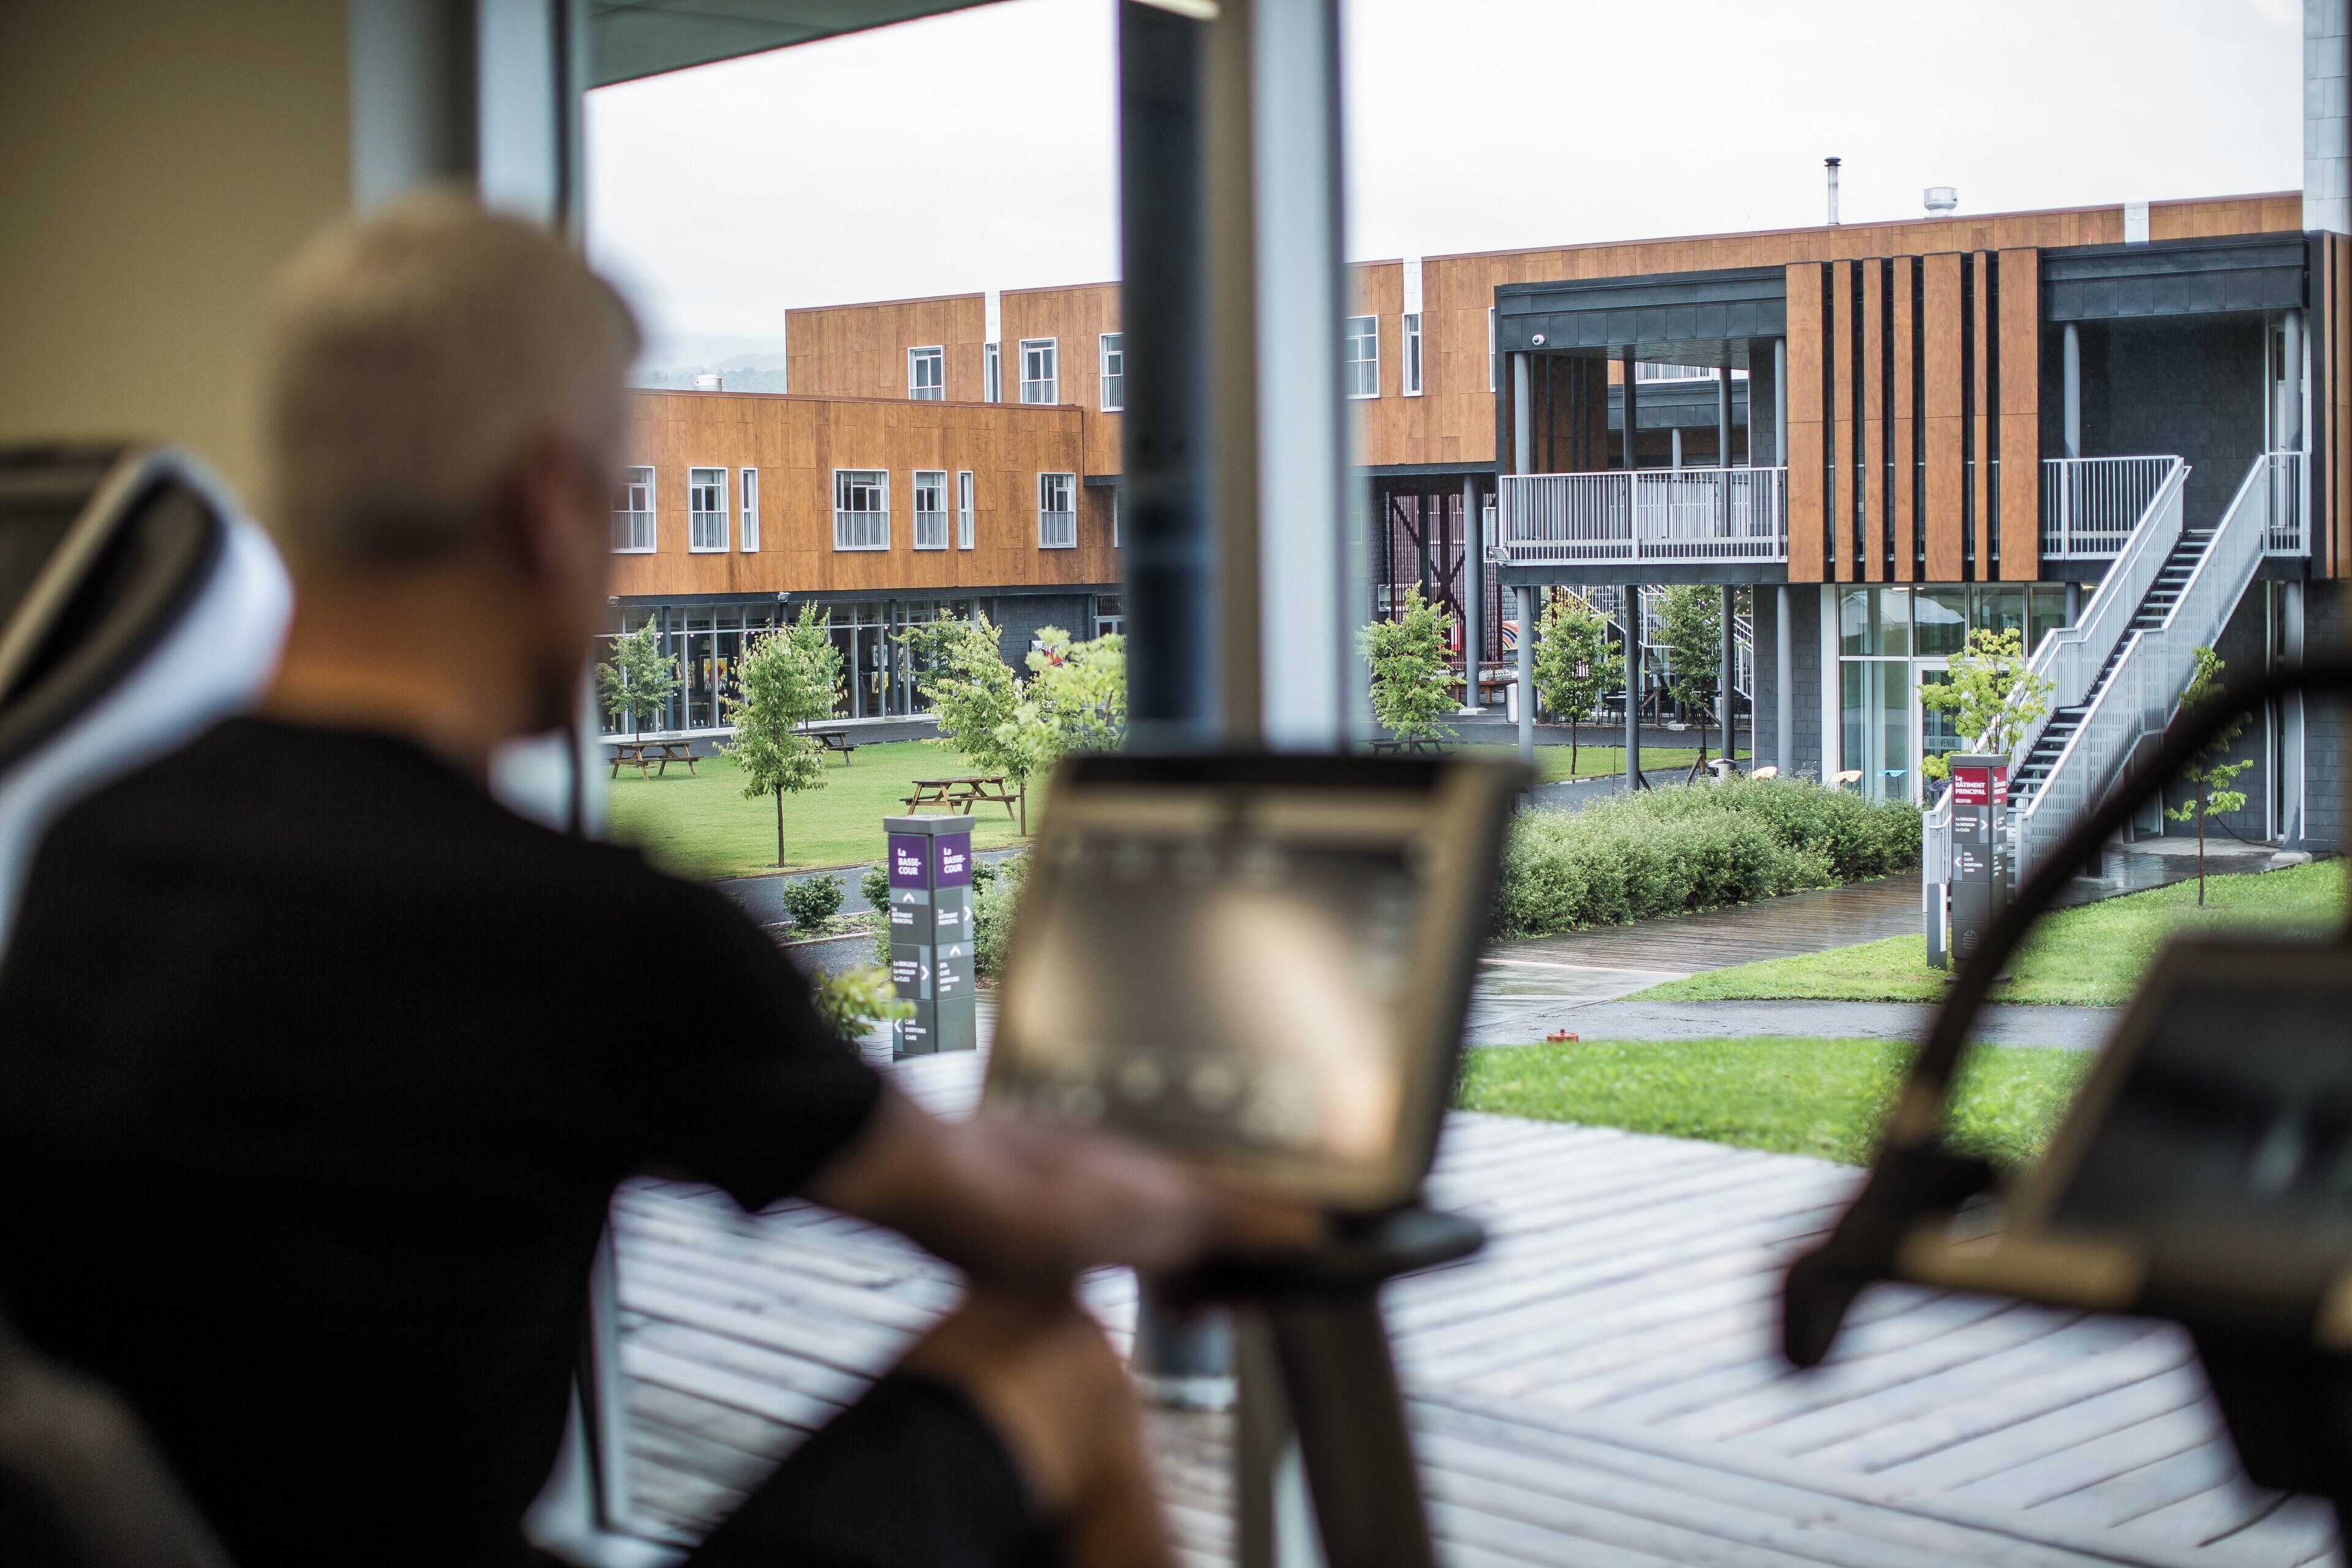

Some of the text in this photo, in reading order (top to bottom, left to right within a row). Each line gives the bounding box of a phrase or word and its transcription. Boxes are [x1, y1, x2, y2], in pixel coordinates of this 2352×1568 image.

[897, 848, 907, 857] La
[943, 847, 952, 856] La
[898, 858, 922, 867] BASSE-
[944, 854, 966, 865] BASSE-
[898, 866, 919, 875] COUR
[944, 864, 963, 874] COUR
